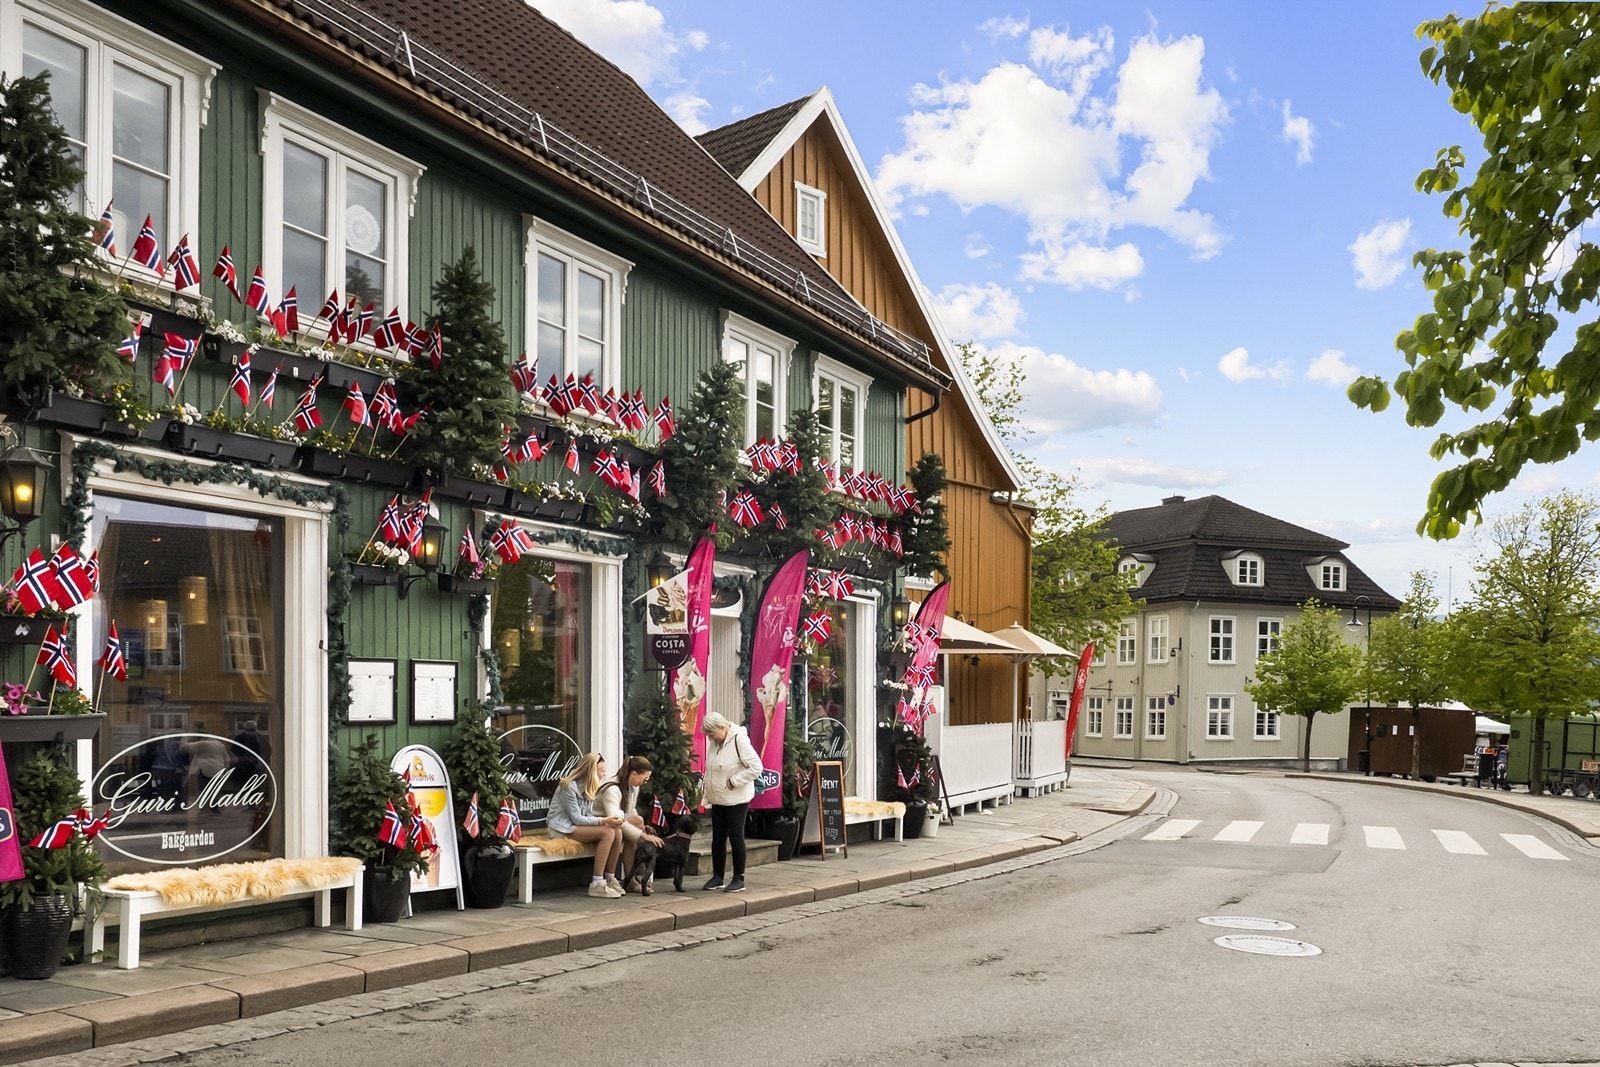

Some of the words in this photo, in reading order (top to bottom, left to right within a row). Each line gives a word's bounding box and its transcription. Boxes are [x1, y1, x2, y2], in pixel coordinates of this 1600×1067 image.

[655, 639, 686, 649] COSTA
[529, 750, 580, 783] Mall
[100, 771, 179, 830] Guri
[180, 766, 268, 811] Malla
[161, 829, 215, 852] Bakgaarden
